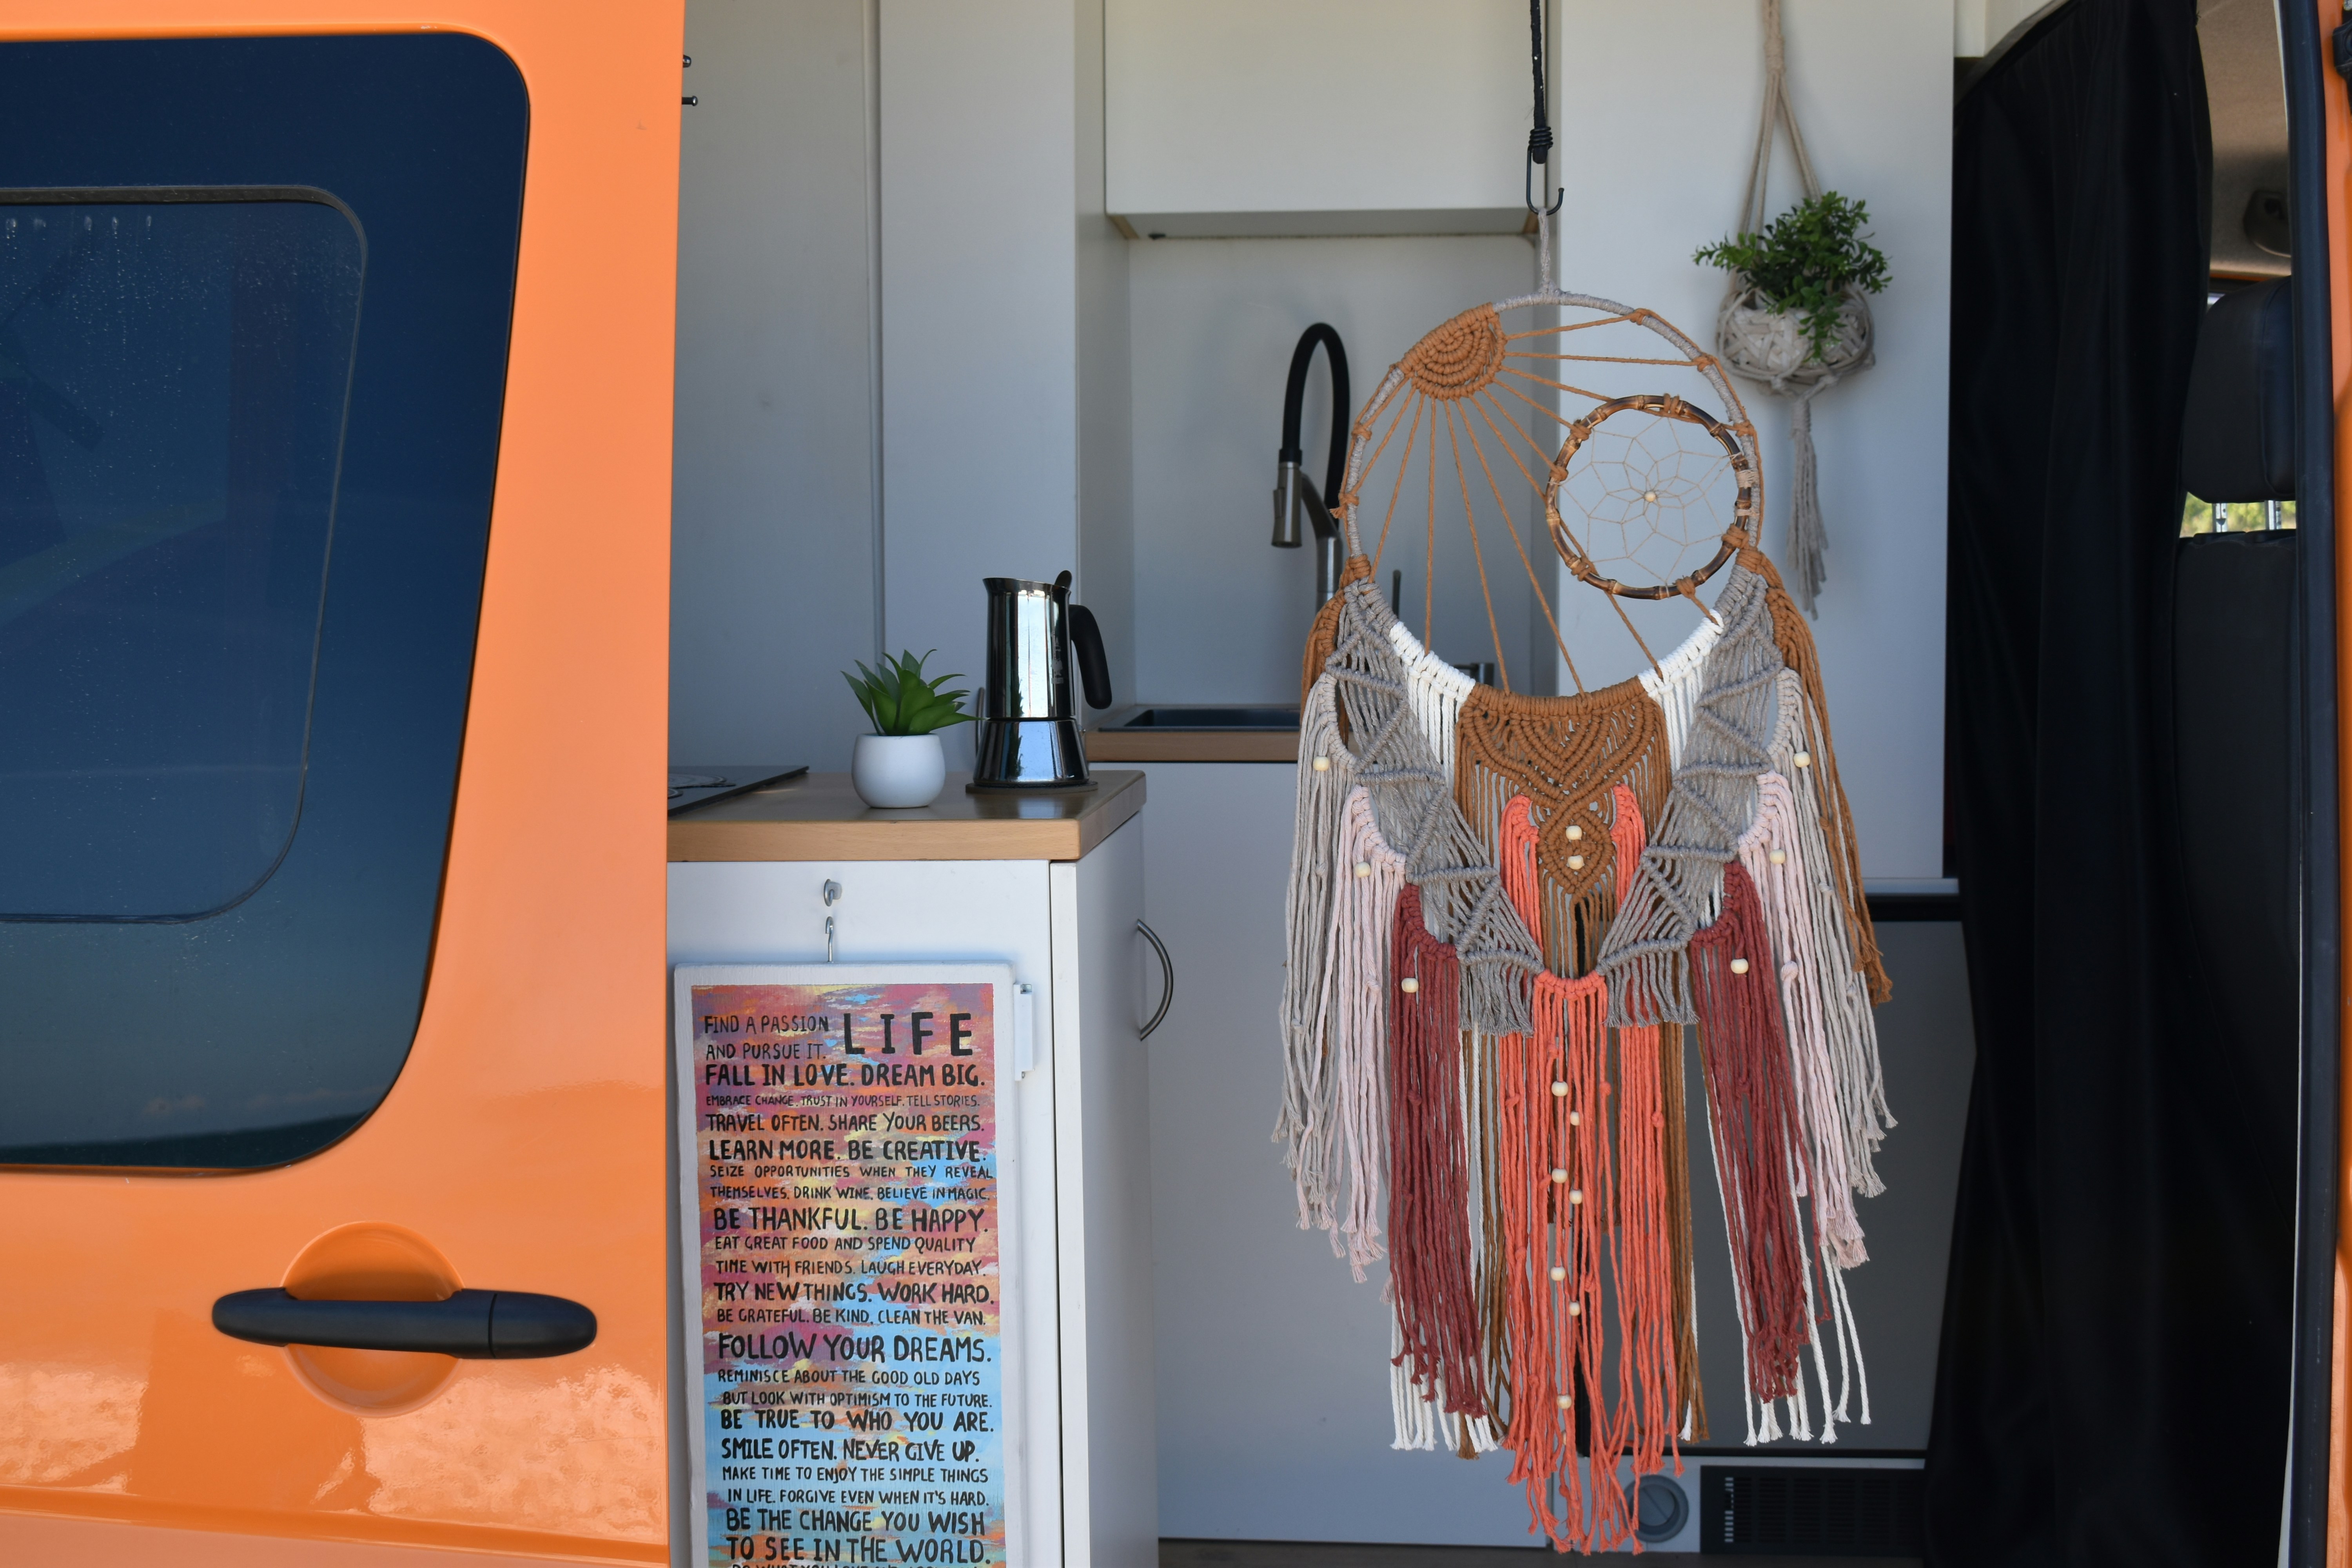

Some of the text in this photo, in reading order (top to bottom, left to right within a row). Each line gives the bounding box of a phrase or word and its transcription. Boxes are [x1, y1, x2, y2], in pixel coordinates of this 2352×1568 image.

[704, 1015, 829, 1034] FIND A PASSION
[706, 1042, 826, 1061] AND PURSUE IT.
[705, 1063, 985, 1087] FALL IN LOVE. DREAM BIG.
[706, 1094, 979, 1107] EMBRACE CHANGE. TRUST IN YOURSELF. TELL STORIES.
[705, 1111, 984, 1132] TRAVEL OFTEN. SHARE YOUR BEERS.
[709, 1140, 986, 1162] LEARN MORE. BE CREATIVE.
[710, 1165, 993, 1179] SEIZE OPPORTUNITIES WHEN THEY REVEAL
[710, 1185, 989, 1201] THEMSELVES. DRINK WINE. BELIEVE IN MAGIC.
[713, 1207, 988, 1232] BE THANKFUL. BE HAPPY.
[715, 1236, 975, 1254] EAT GREAT FOOD AND SPEND QUALITY
[715, 1259, 985, 1278] TIME WITH FRIENDS. LAUGH EVERYDAY.
[713, 1281, 994, 1304] TRY NEW THINGS. WORK HARD.
[717, 1308, 985, 1325] BE GRATEFUL. BE KIND. CLEAN THE VAN.
[718, 1331, 991, 1363] FOLLOW YOUR DREAMS.
[718, 1369, 980, 1386] REMINISCE ABOUT THE GOOD OLD DAYS
[723, 1391, 992, 1408] BUT LOOK WITH OPTIMISM TO THE FUTURE.
[720, 1408, 994, 1432] BE TRUE TO WHO YOU ARE.
[721, 1437, 979, 1462] SMILE OFTEN. NEVER GIVE UP.
[722, 1466, 988, 1484] MAKE TIME TO ENJOY THE SIMPLE THINGS
[728, 1488, 989, 1506] IN LIFE. FORGIVE EVEN WHEN IT'S HARD.
[726, 1508, 985, 1536] BE THE CHANGE YOU WISH
[726, 1535, 991, 1564] TO SEE IN THE WORLD.
